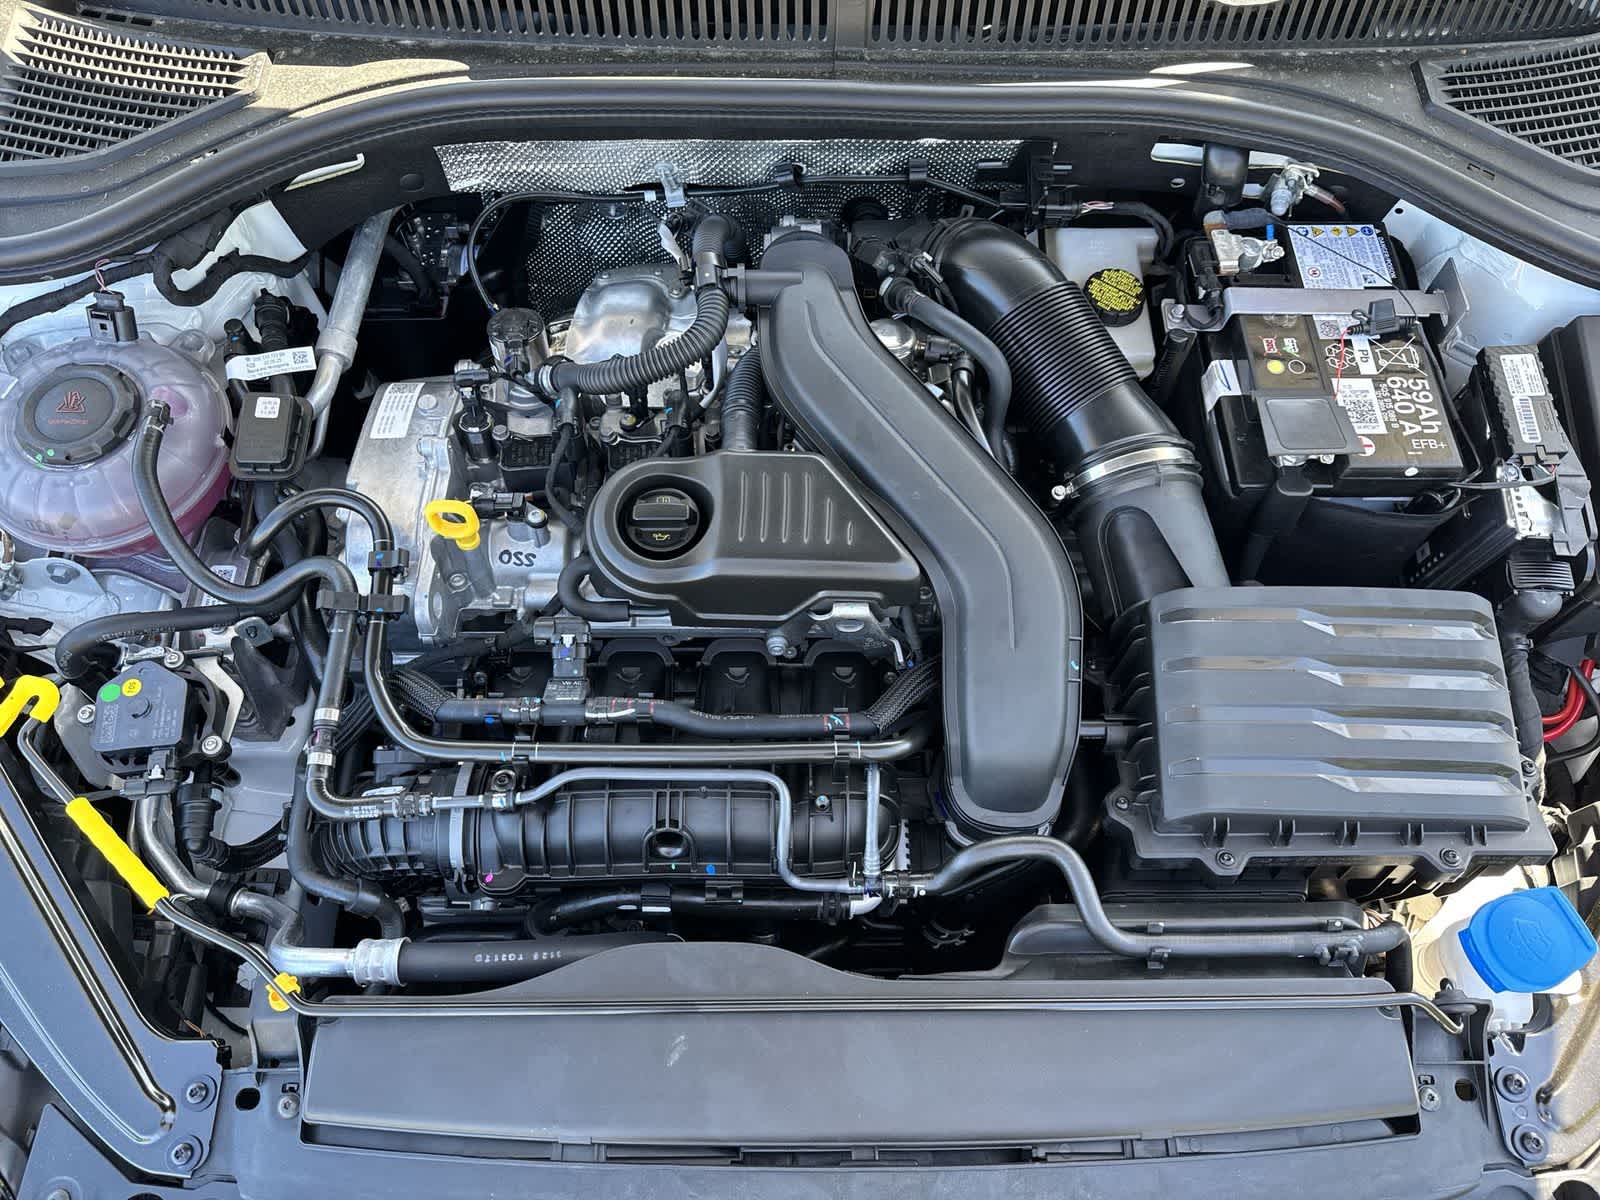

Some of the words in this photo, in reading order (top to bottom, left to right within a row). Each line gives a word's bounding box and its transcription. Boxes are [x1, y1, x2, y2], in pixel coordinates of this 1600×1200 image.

[1358, 349, 1369, 363] Pb
[1386, 376, 1416, 414] 640
[1407, 377, 1442, 434] 59Ah
[1399, 420, 1422, 436] A
[1412, 439, 1448, 449] EFB+
[498, 549, 537, 567] OSS
